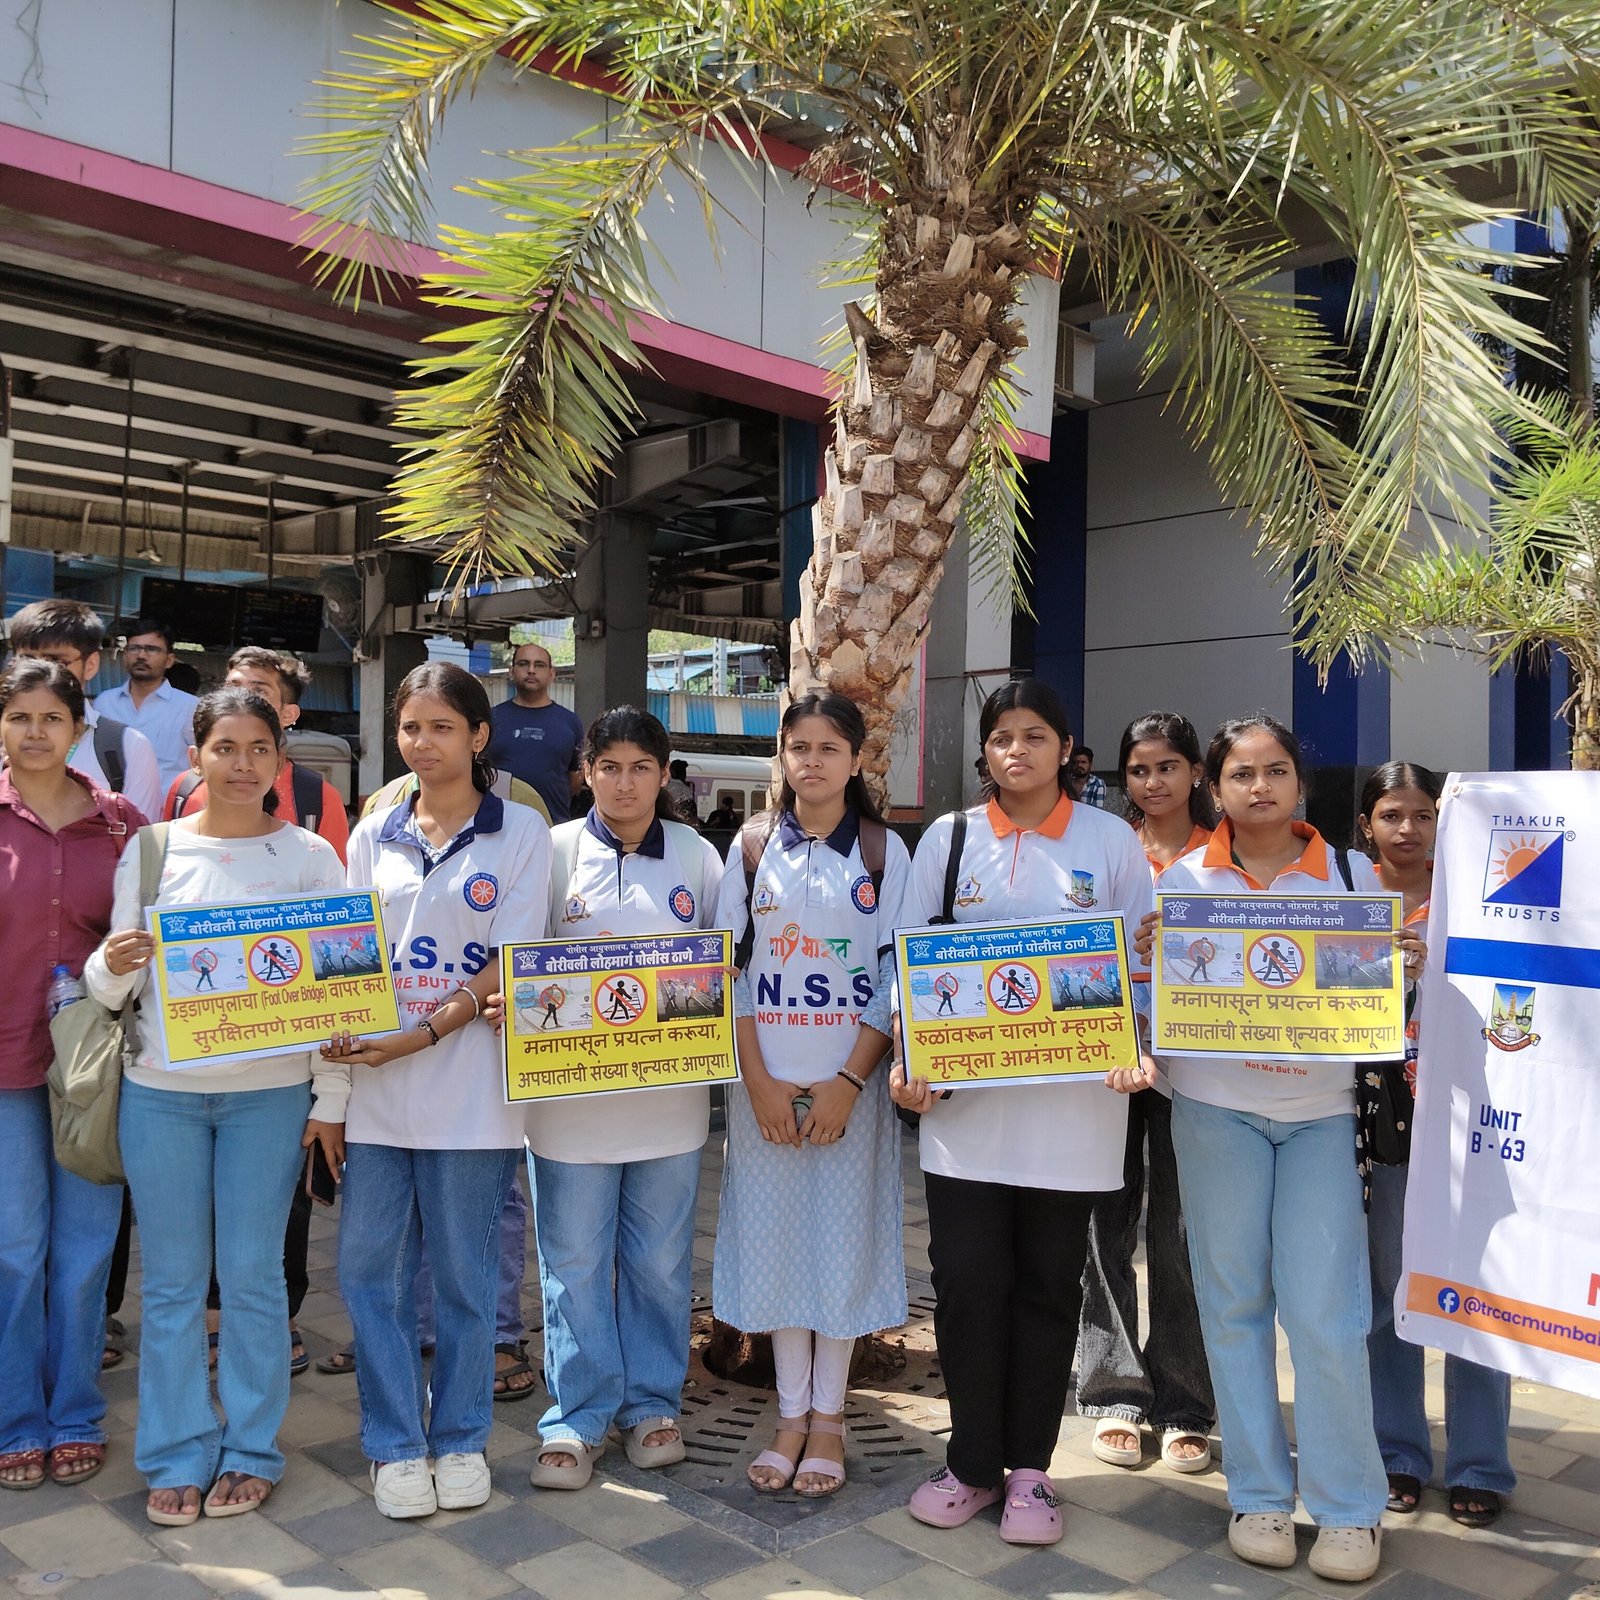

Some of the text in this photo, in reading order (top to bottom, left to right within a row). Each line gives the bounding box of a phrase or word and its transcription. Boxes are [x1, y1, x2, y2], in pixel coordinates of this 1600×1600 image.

[1492, 815, 1566, 827] THAKUR
[210, 909, 233, 919] पोलीस
[311, 900, 326, 910] मुंबई
[1208, 912, 1344, 926] बोरीवली लोहमार्ग पोलीस ठाणे
[1212, 900, 1236, 909] पोलीस
[1322, 901, 1340, 912] मुंबई
[1482, 906, 1560, 922] TRUSTS
[188, 914, 236, 936] बोरीवली
[239, 911, 284, 930] लोहमार्ग
[285, 908, 323, 926] पोलीस
[326, 906, 350, 922] ठाणे
[566, 945, 588, 954] पोलीस
[660, 938, 674, 949] मुंबई
[935, 944, 979, 960] बोरीवली
[981, 940, 1023, 958] लोहमार्ग
[1025, 939, 1062, 954] पोलीस
[1064, 936, 1088, 950] ठाणे
[952, 934, 974, 944] पोलीस
[1051, 926, 1066, 937] मुंबई
[391, 936, 488, 976] .S.S
[546, 954, 588, 973] बोरीवली
[591, 951, 634, 970] लोहमार्ग
[635, 949, 670, 966] पोलीस
[671, 946, 693, 963] ठाणे
[418, 975, 450, 990] BUT
[758, 973, 874, 1007] N.S.S
[168, 992, 258, 1023] उड्डाणपुलाचा
[261, 988, 281, 1010] (Foot
[282, 988, 300, 1004] Over
[301, 983, 327, 1002] Bridge)
[328, 980, 361, 999] वापर
[363, 976, 388, 995] करा
[1171, 991, 1389, 1016] मनापासून प्रयत्न करूया,
[192, 1007, 376, 1053] सुरक्षितपणे प्रवास करा.
[758, 1011, 783, 1024] NOT
[788, 1013, 809, 1026] ME
[814, 1013, 844, 1026] BUT
[914, 1012, 1125, 1046] रुळांवरून चालणे म्हणजे
[524, 1023, 721, 1056] मनापासून प्रयत्न करूया,
[1164, 1019, 1237, 1041] अपघातांची
[1240, 1020, 1282, 1042] संख्या
[1285, 1025, 1339, 1050] शून्यवर
[1342, 1025, 1396, 1050] आणूया!
[518, 1052, 730, 1088] अपघातांची संख्या शून्यवर आणूया!
[930, 1039, 1115, 1079] मृत्यूला आमंत्रण देणे.
[1245, 1061, 1260, 1069] Not
[1480, 1104, 1522, 1131] UNIT
[1471, 1131, 1482, 1153] B
[1501, 1138, 1525, 1162] 63
